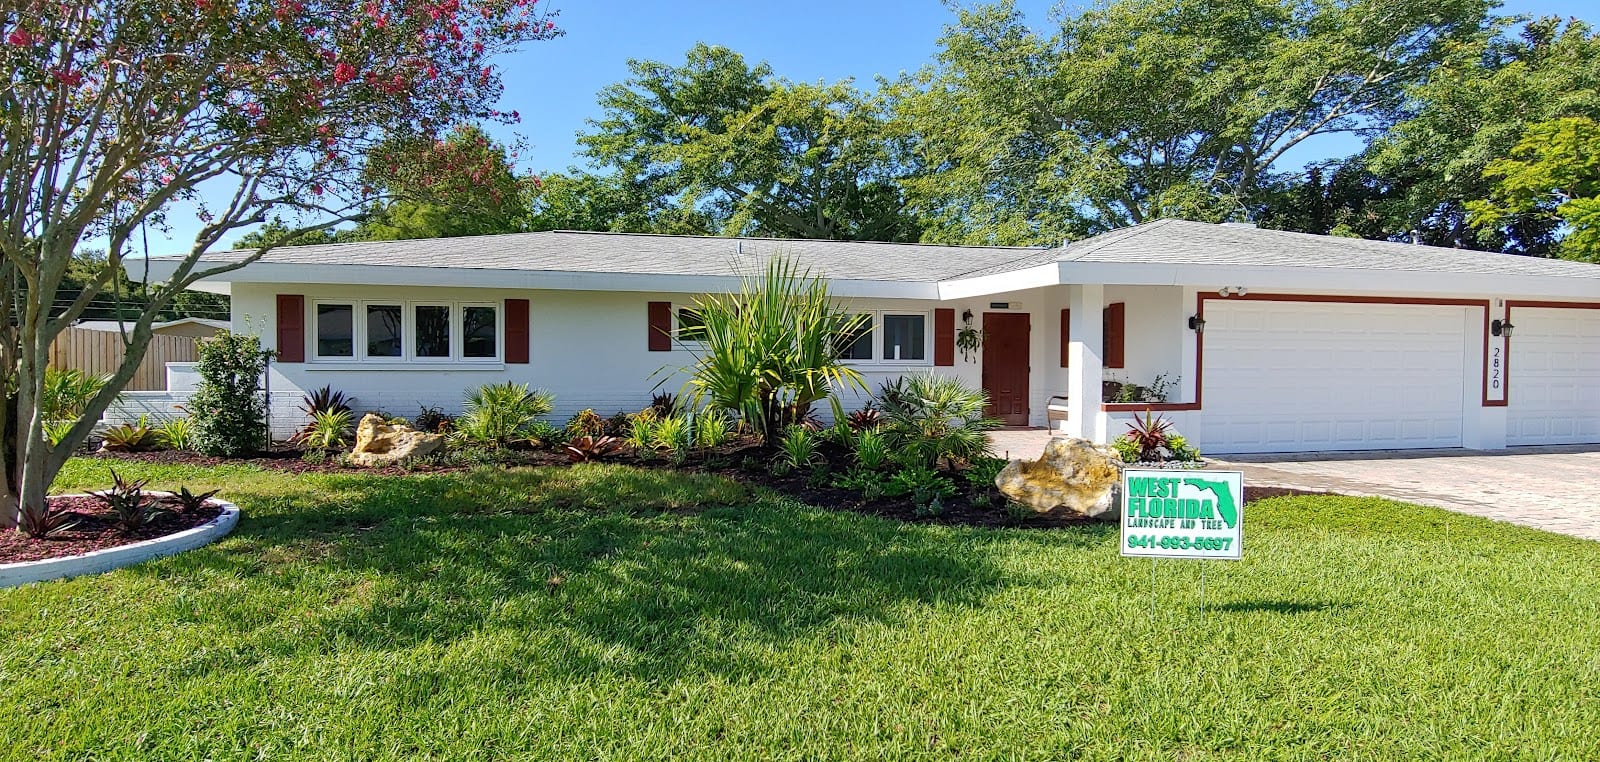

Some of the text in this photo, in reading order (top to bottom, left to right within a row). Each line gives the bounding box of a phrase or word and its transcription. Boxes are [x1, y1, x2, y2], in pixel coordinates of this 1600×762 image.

[1492, 347, 1500, 389] 2820
[1127, 476, 1182, 498] WEST
[1127, 497, 1215, 519] FLORIDA
[1127, 518, 1223, 530] LANDSCAPE AND TREE
[1127, 534, 1234, 551] 941-993-5697
